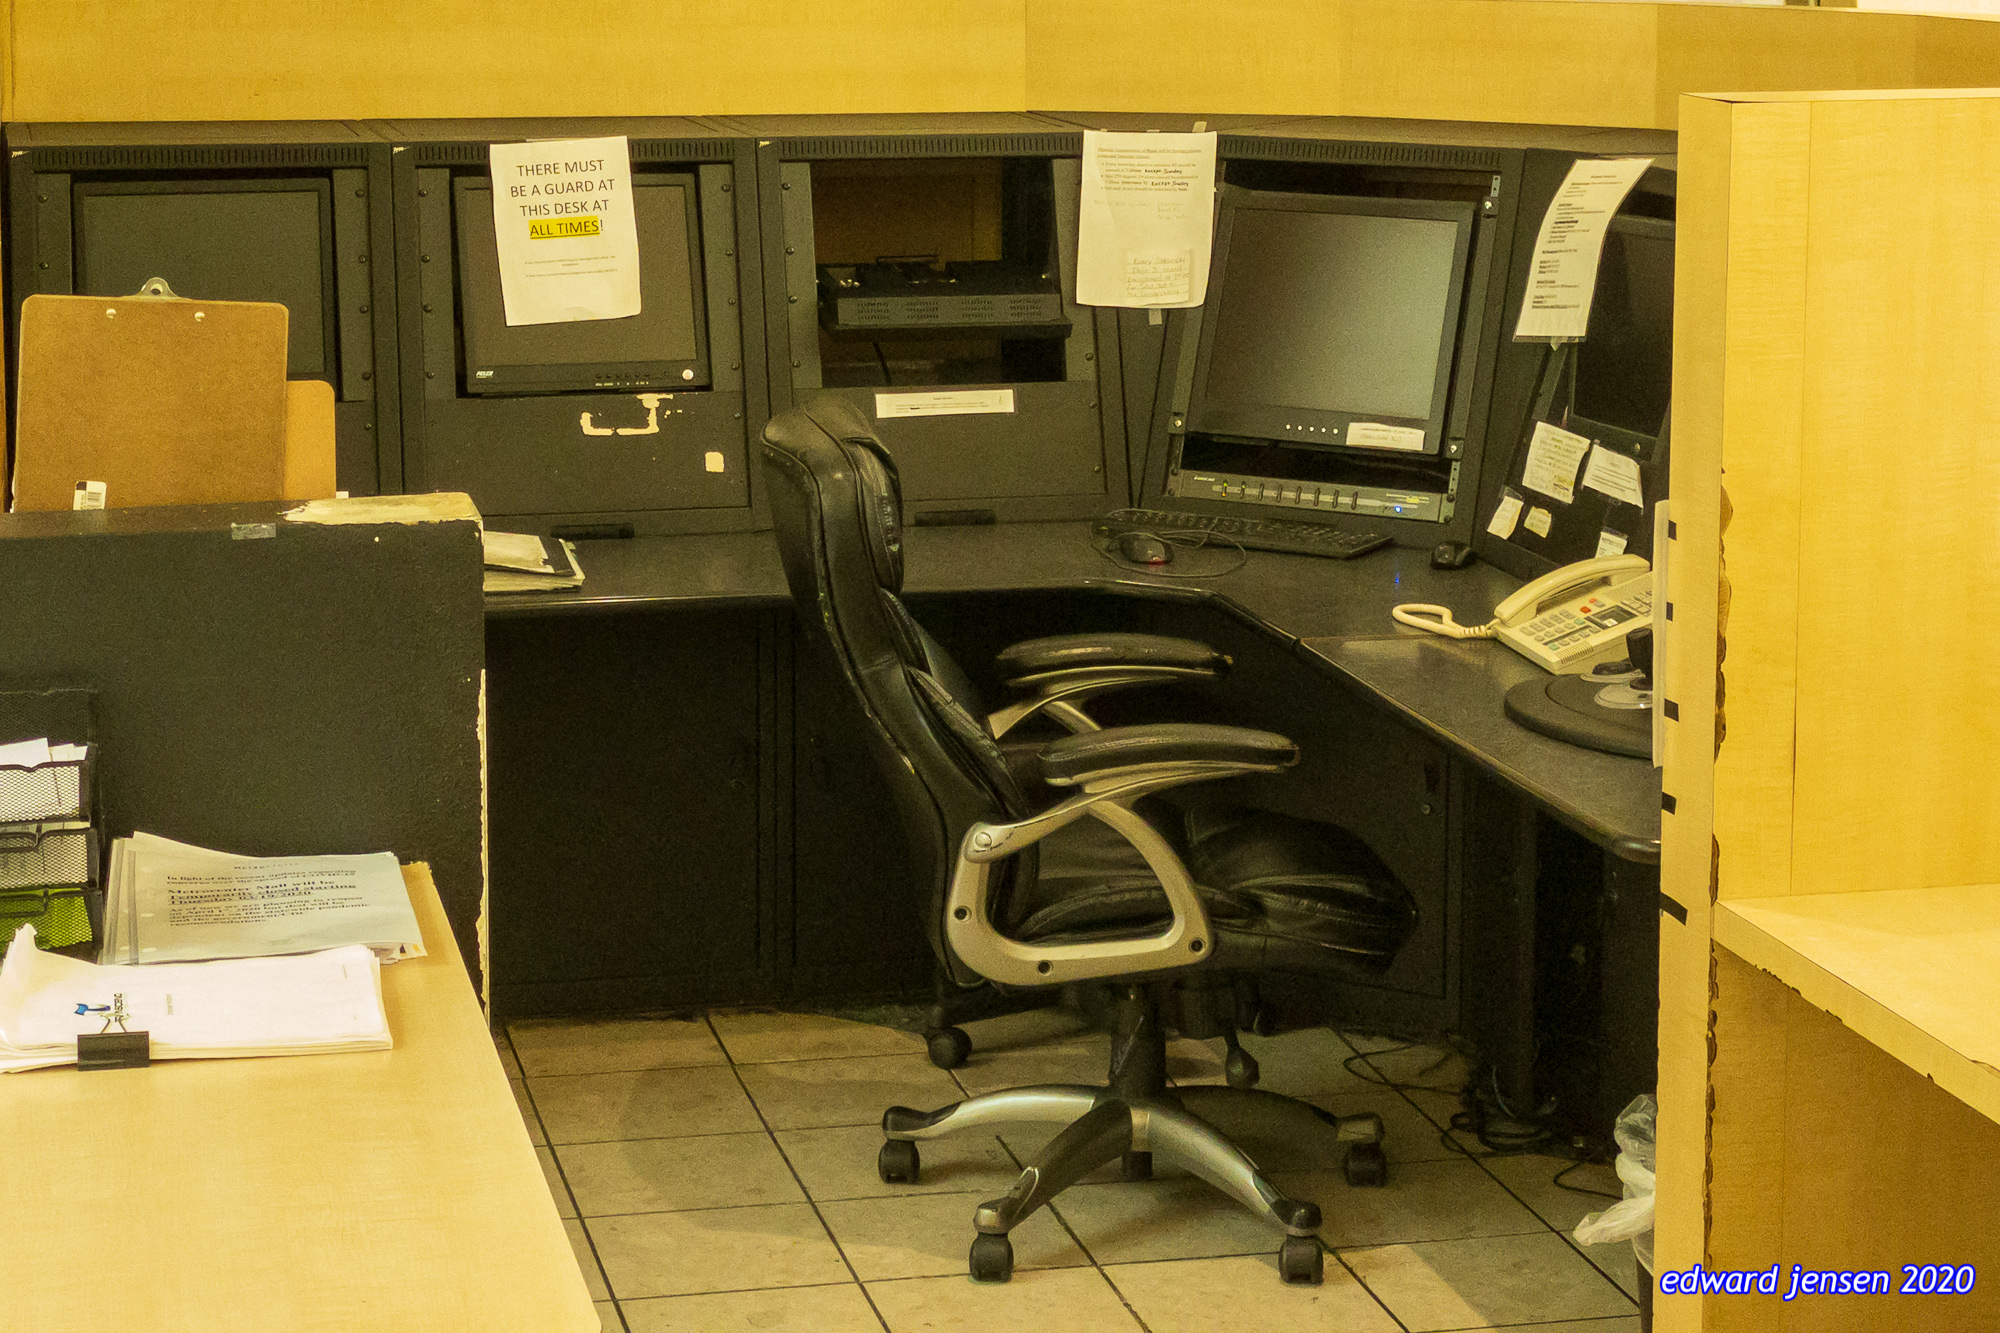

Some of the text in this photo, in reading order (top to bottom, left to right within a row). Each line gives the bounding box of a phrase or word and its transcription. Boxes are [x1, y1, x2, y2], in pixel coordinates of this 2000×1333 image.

[516, 159, 605, 177] THERE MUST
[510, 178, 616, 198] BE A GUARD AT
[519, 199, 610, 217] THIS DESK AT
[530, 219, 604, 238] ALL TIMES!
